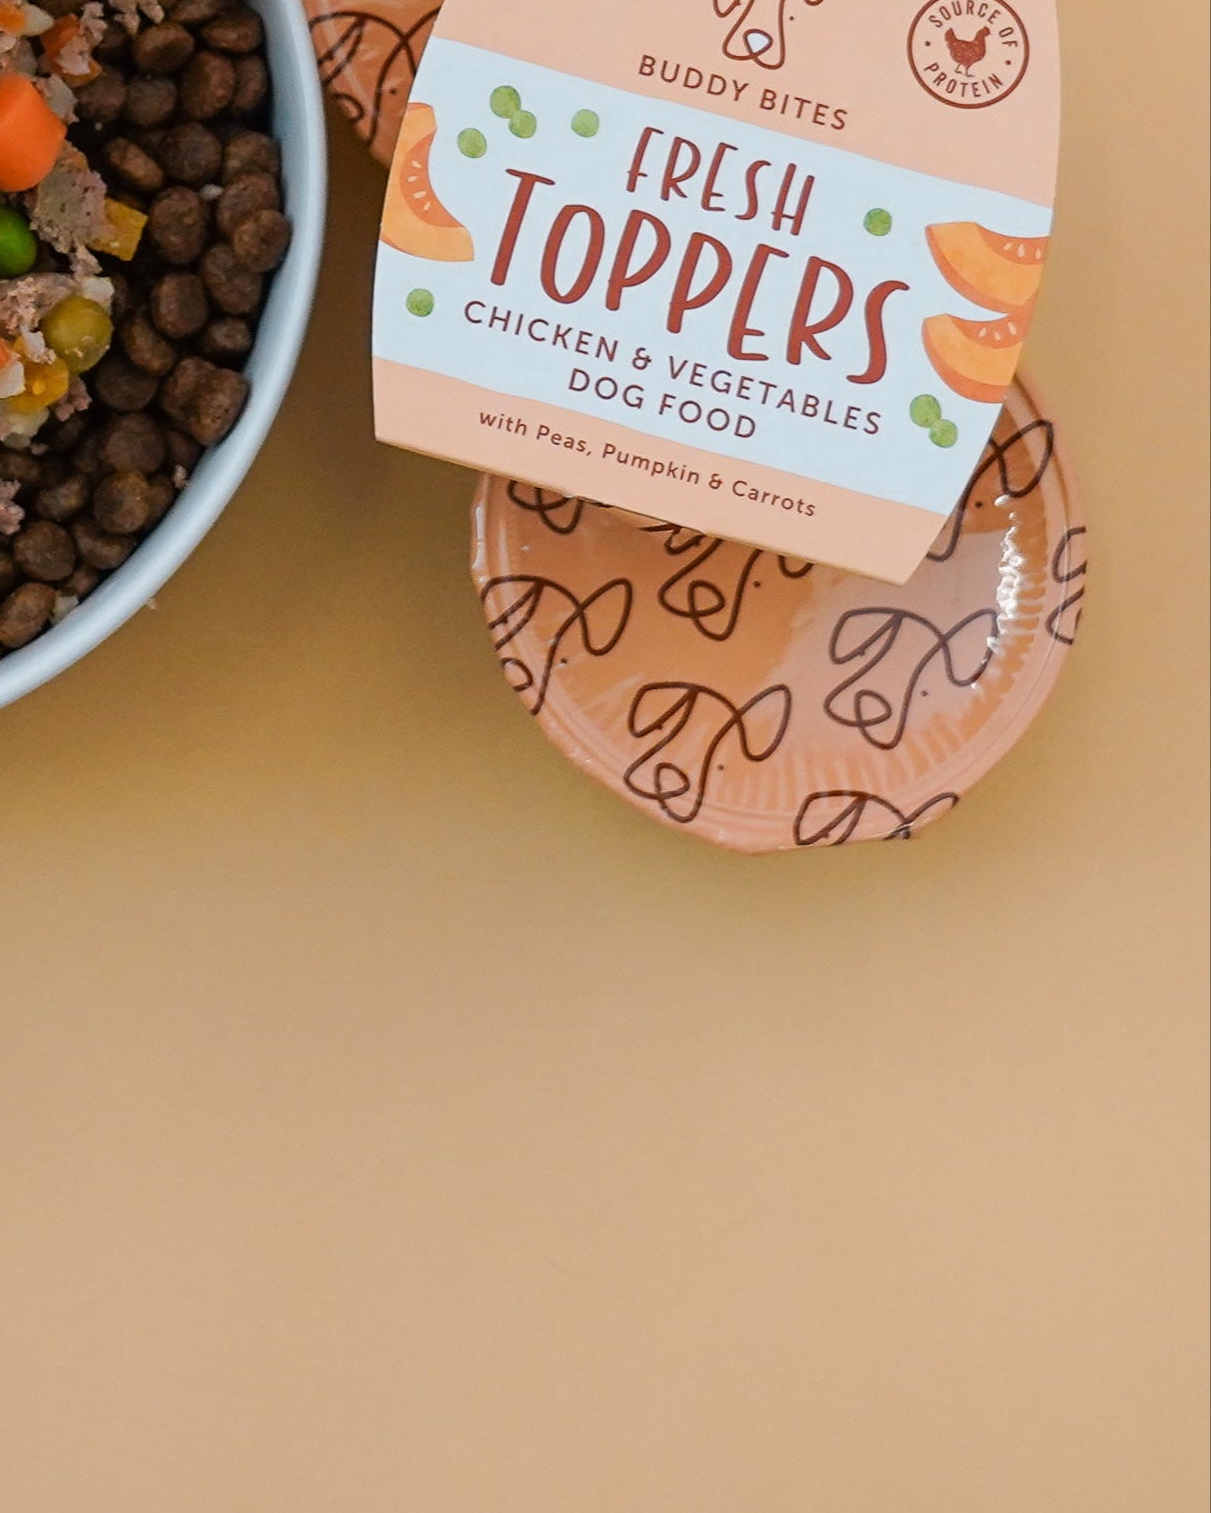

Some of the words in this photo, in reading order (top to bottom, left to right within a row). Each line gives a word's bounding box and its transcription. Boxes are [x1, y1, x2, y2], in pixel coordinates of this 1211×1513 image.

[928, 0, 1001, 28] SOURCE
[998, 26, 1018, 47] OF
[638, 54, 749, 102] BUDDY
[758, 88, 849, 131] BITES
[923, 62, 1004, 97] PROTEIN
[626, 126, 815, 236] FRESH
[489, 167, 910, 385] TOPPERS
[463, 300, 619, 362] CHICKEN
[631, 347, 652, 370] &
[668, 356, 882, 435] VEGETABLES
[567, 368, 645, 409] DOG
[658, 393, 757, 439] FOOD
[479, 410, 528, 436] with
[536, 425, 592, 456] Peas,
[602, 443, 700, 485] Pumpkin
[708, 472, 724, 490] &
[732, 480, 817, 518] Carrots
